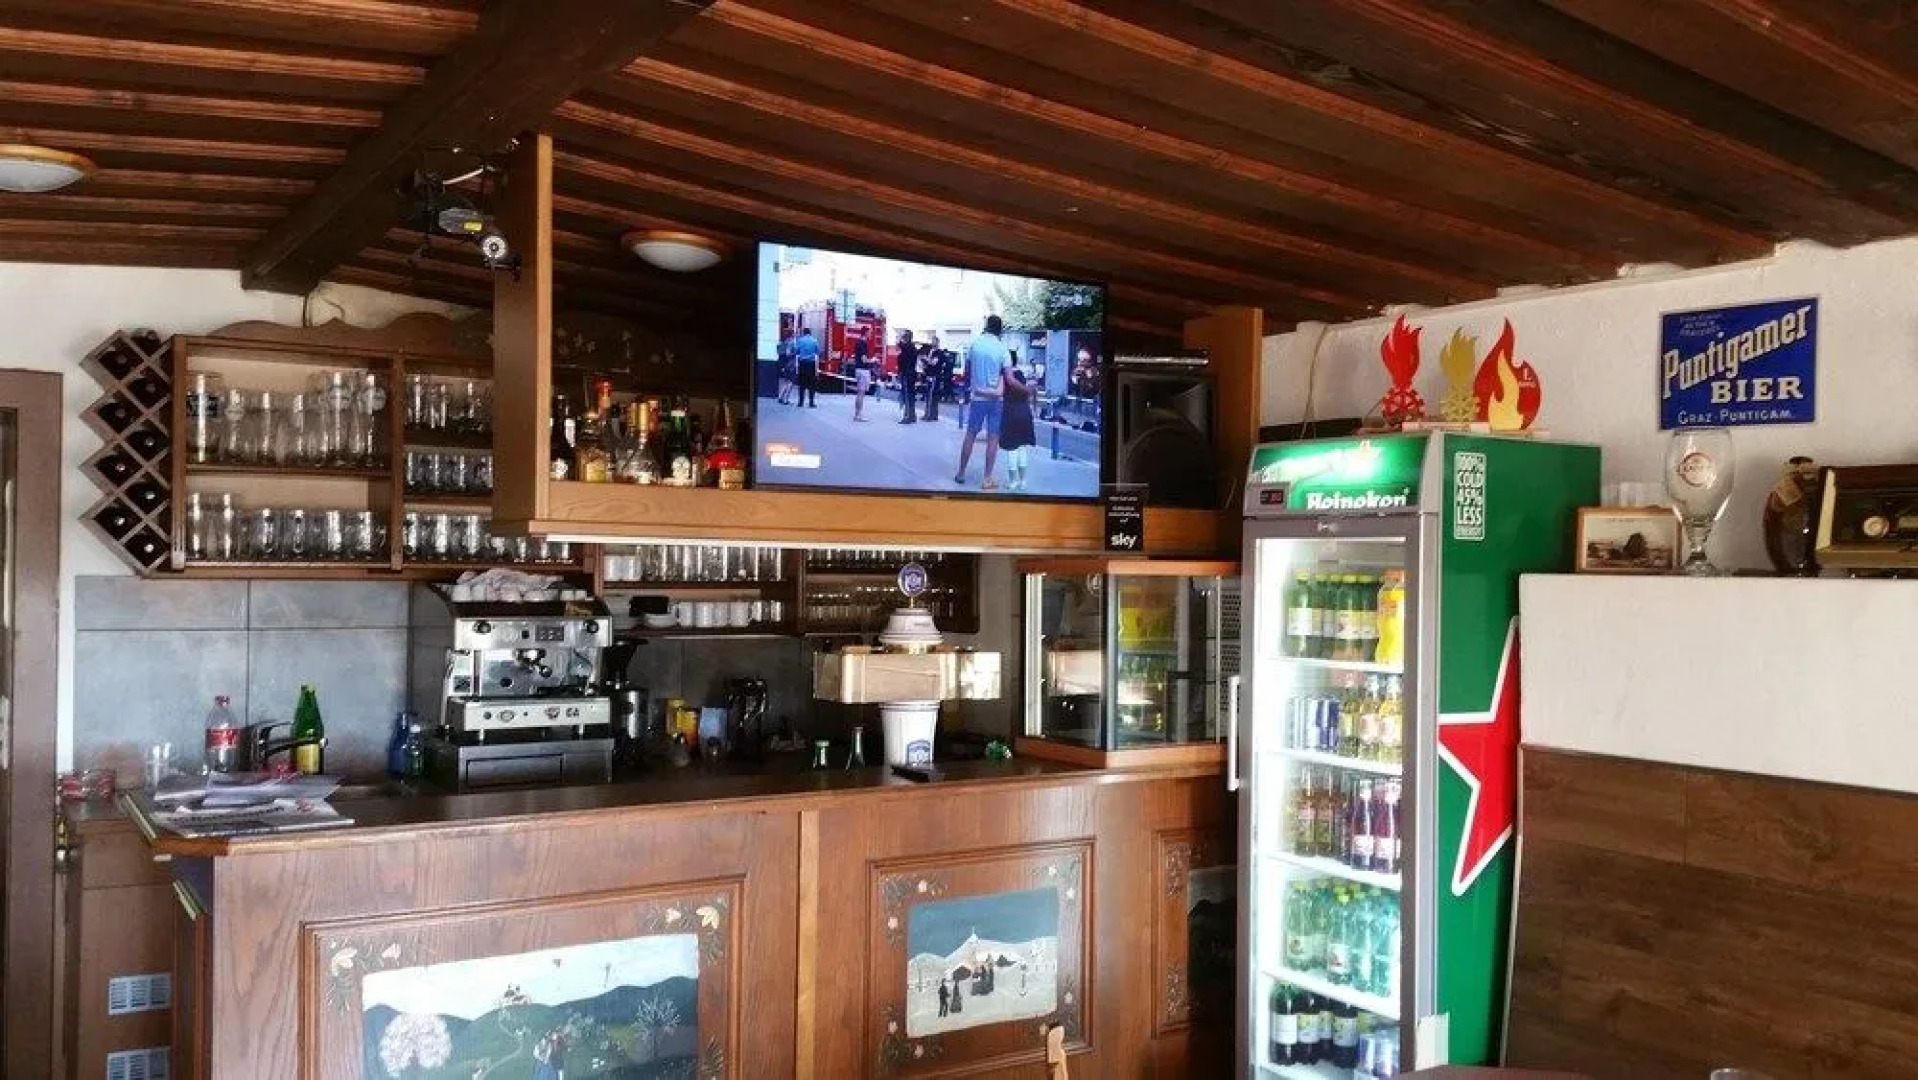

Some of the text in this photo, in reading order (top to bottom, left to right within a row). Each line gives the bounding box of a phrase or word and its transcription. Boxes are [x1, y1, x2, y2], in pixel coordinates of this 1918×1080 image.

[1663, 305, 1811, 399] Puntigamer
[1710, 375, 1804, 404] BIER
[1110, 532, 1138, 549] sky
